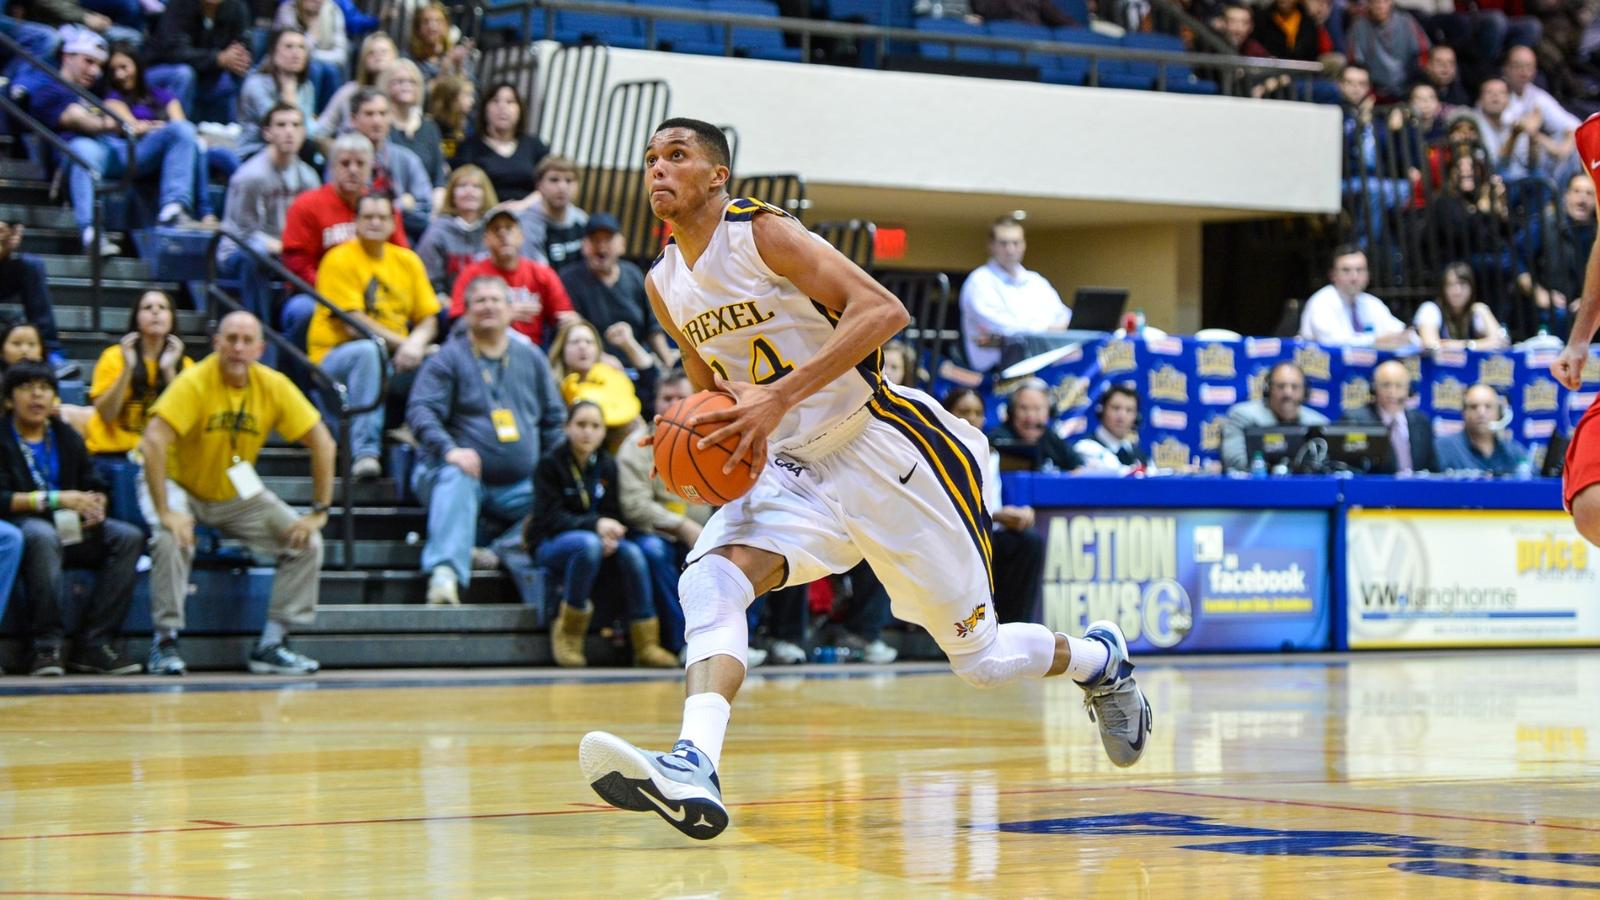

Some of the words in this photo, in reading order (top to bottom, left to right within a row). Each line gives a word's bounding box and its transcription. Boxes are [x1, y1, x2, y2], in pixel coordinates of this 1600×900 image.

[1045, 515, 1177, 582] ACTION
[1517, 531, 1588, 576] price
[1209, 562, 1306, 594] facebook
[1043, 581, 1142, 643] NEWS
